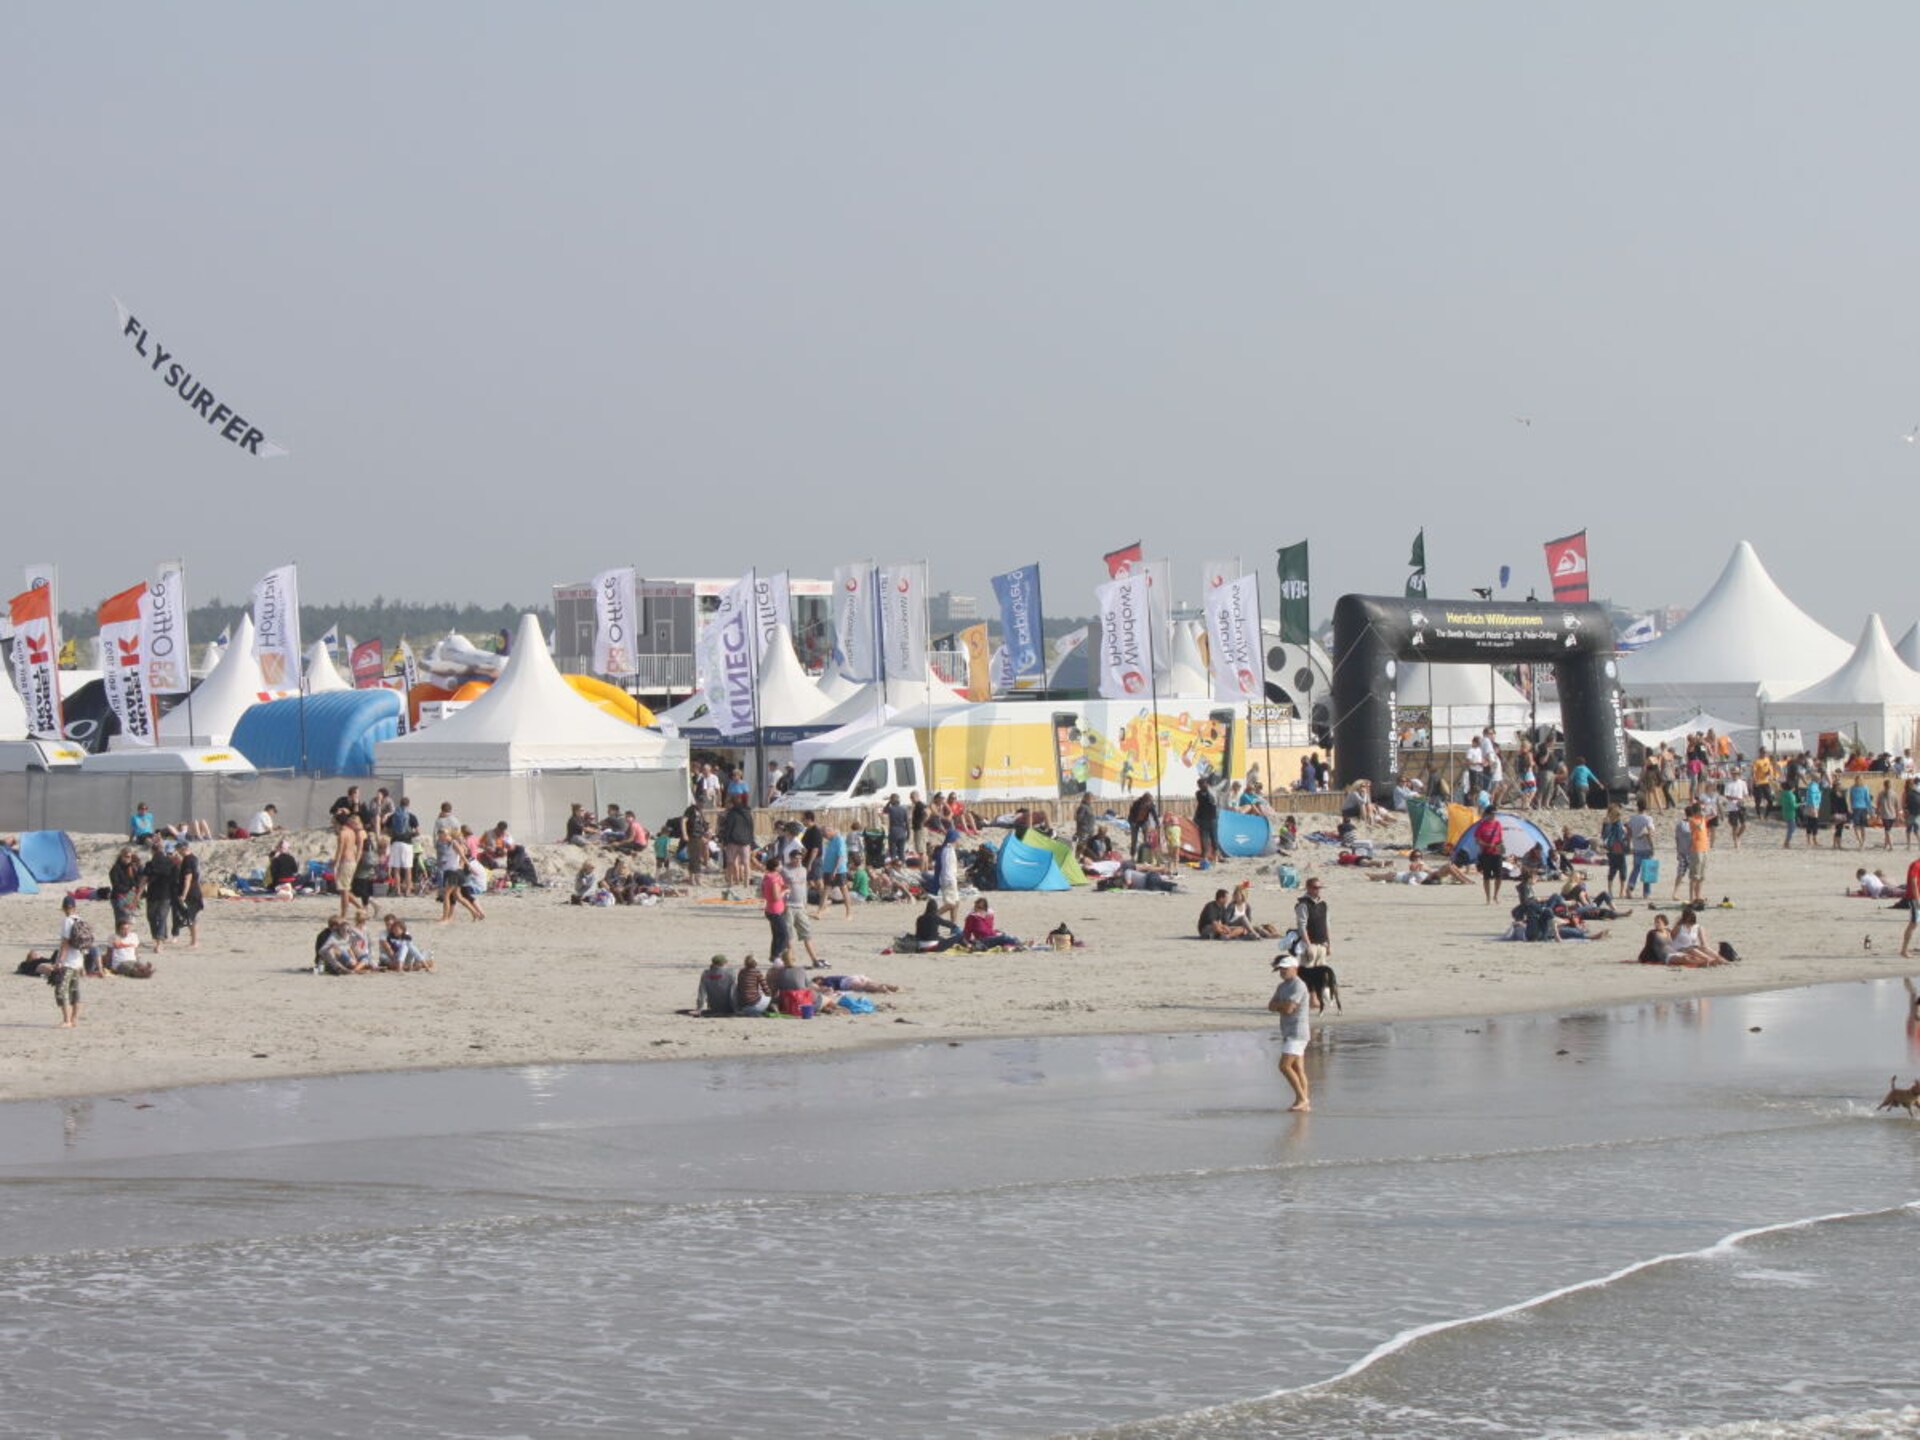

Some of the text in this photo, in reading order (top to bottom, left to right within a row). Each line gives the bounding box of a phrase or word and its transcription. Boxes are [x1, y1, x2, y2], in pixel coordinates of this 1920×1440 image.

[124, 316, 264, 455] FLYSURFER
[1446, 612, 1544, 626] Herzlich Willkommen
[1610, 690, 1623, 737] Beetle
